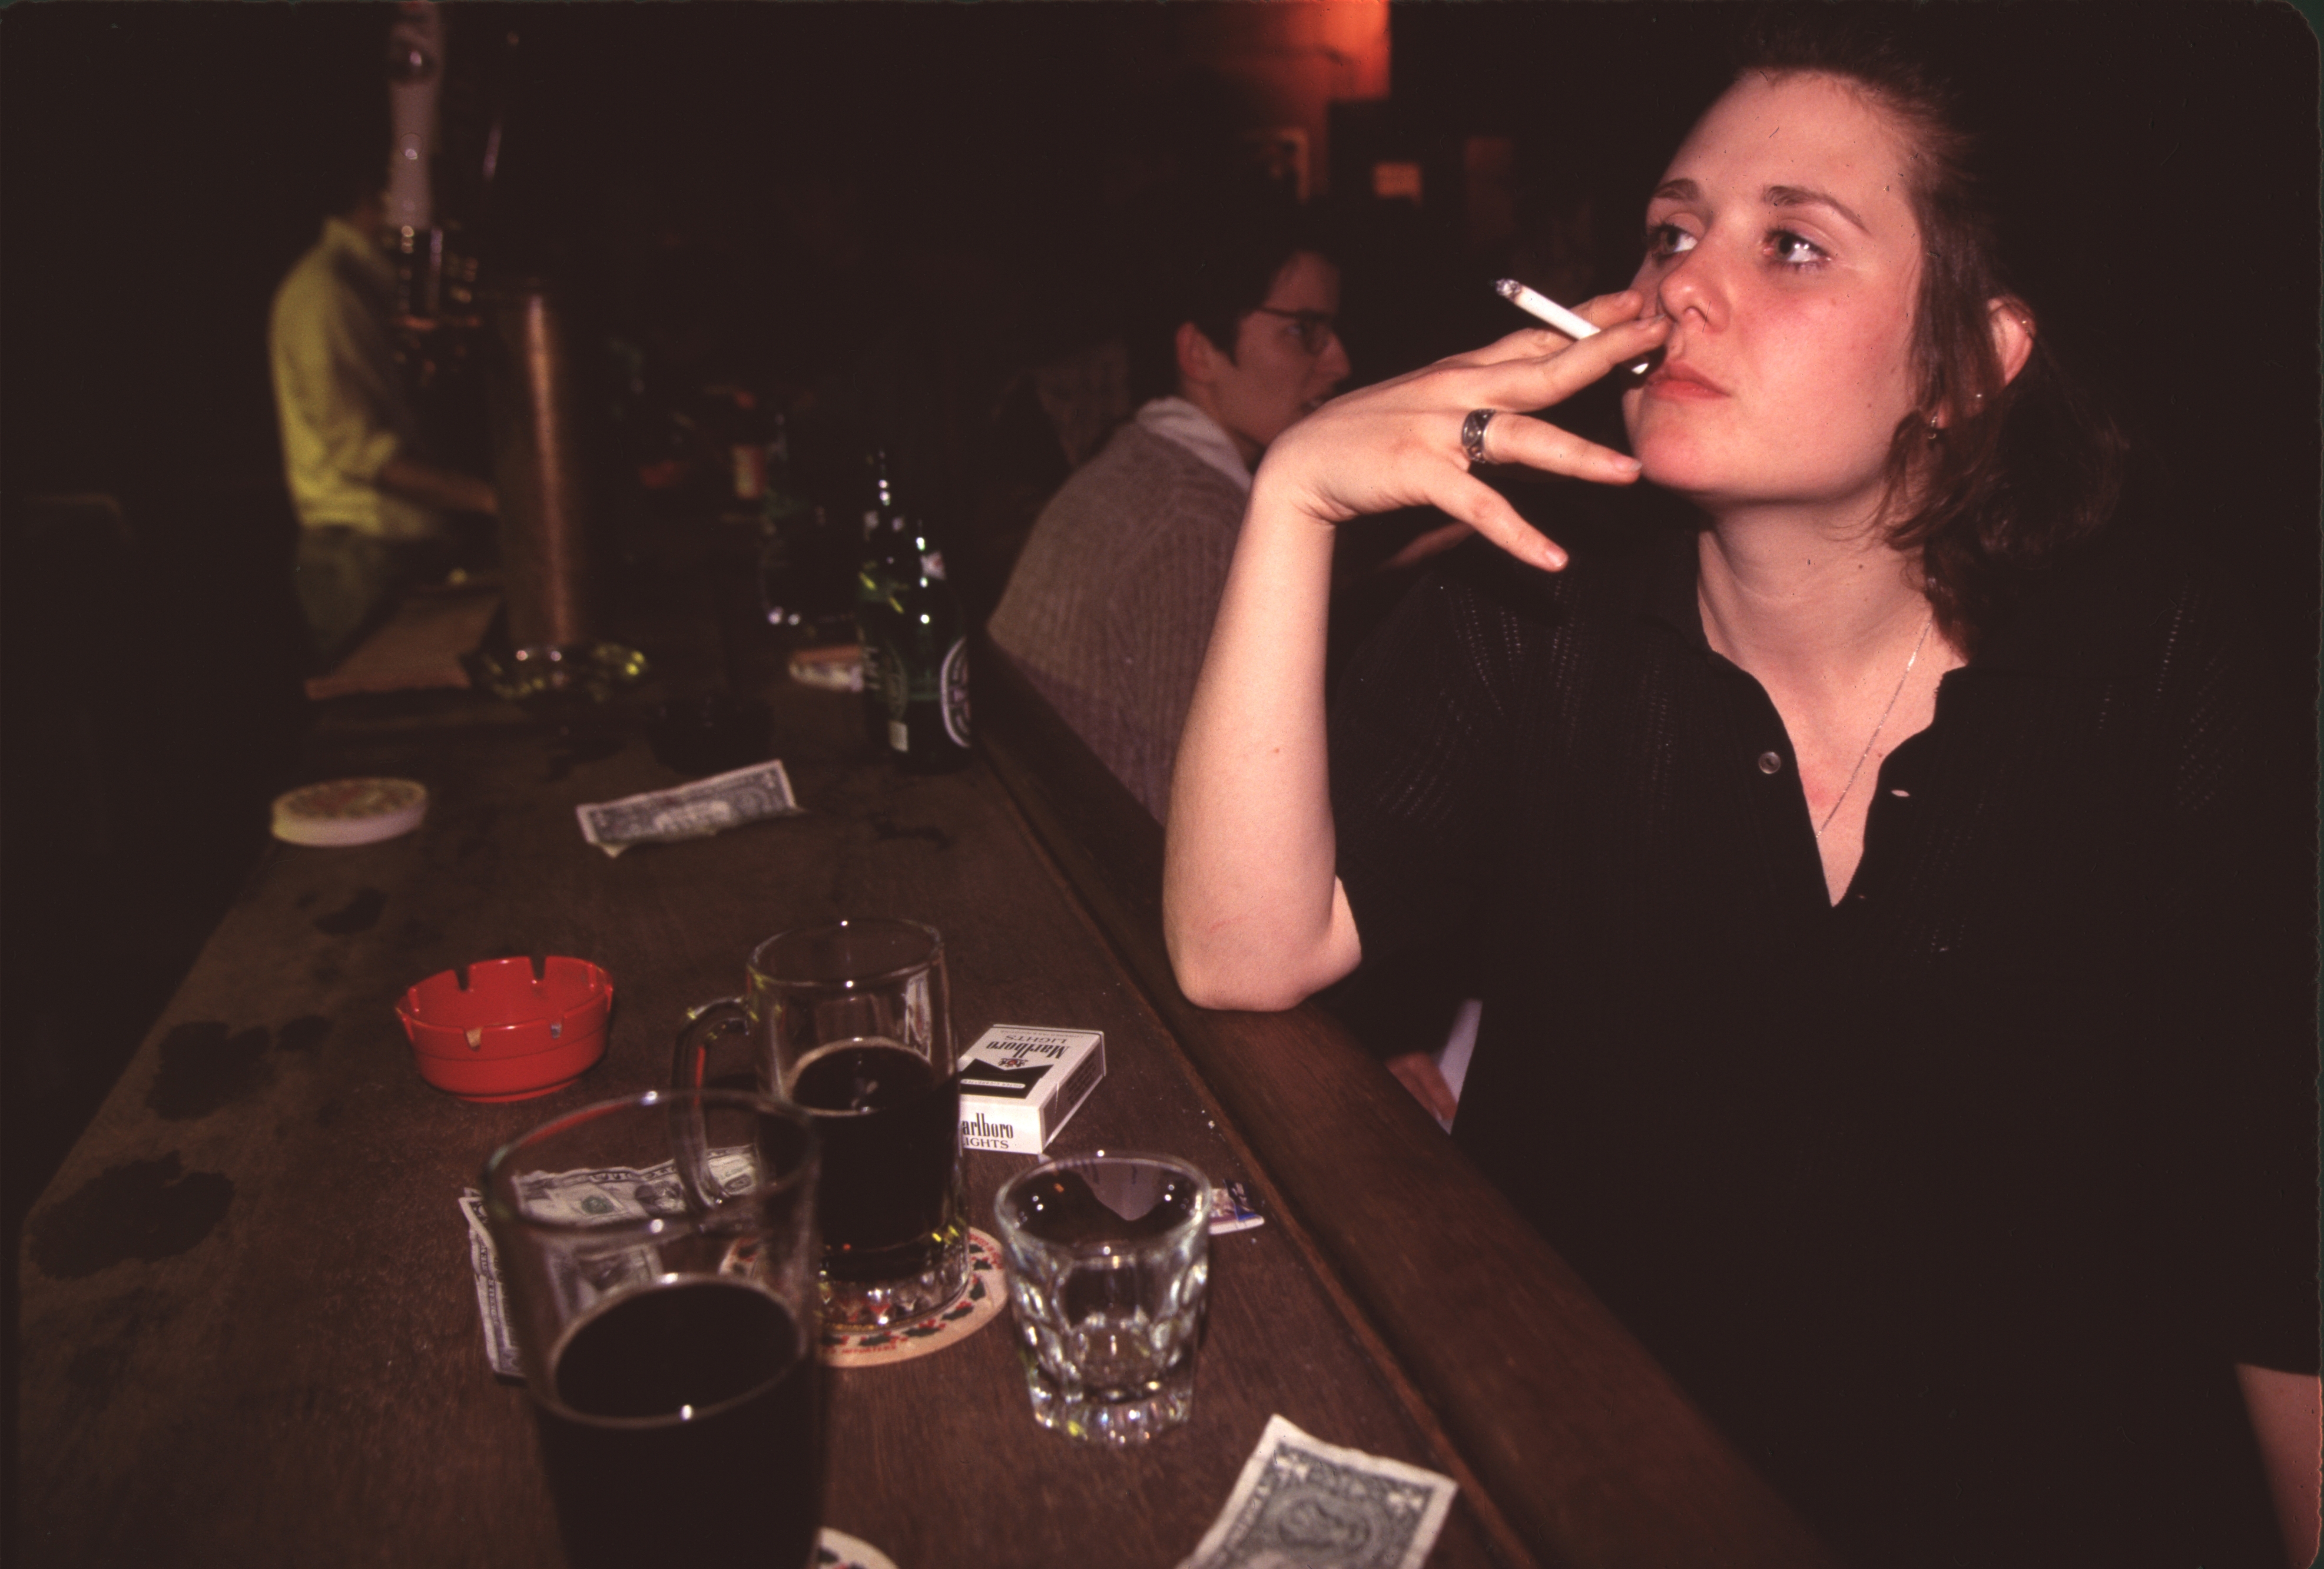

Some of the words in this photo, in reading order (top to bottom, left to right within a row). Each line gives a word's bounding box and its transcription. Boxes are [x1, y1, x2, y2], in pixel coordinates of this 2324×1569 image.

[1005, 1035, 1067, 1043] LIGHTS
[986, 1041, 1071, 1059] Marlboro
[962, 1112, 1014, 1138] arlboro
[963, 1137, 1009, 1149] IGHTS
